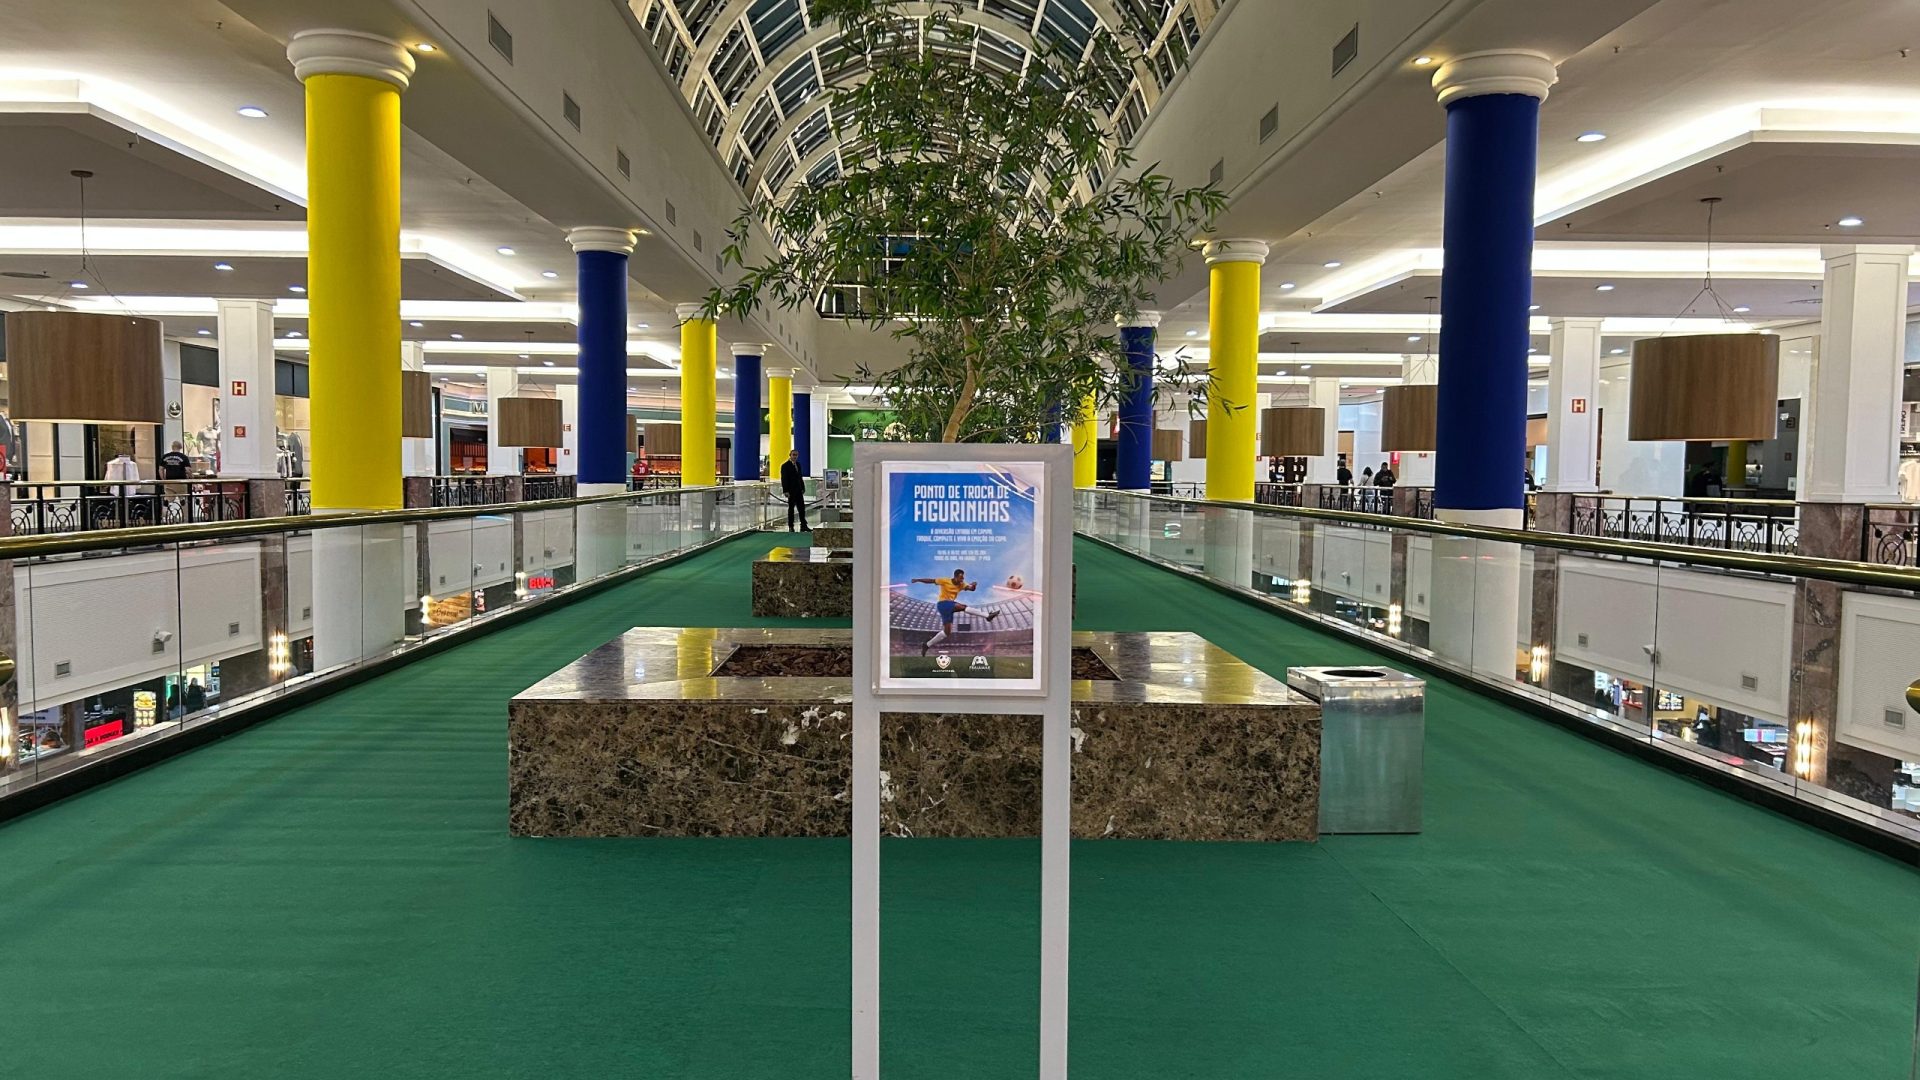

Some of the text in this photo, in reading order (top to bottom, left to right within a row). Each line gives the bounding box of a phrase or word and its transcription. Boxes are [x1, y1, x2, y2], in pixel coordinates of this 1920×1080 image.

[234, 383, 245, 395] H
[1573, 400, 1584, 412] H
[914, 485, 1010, 499] PONTO DE TROCA DE
[914, 500, 1010, 523] FIGURINHAS
